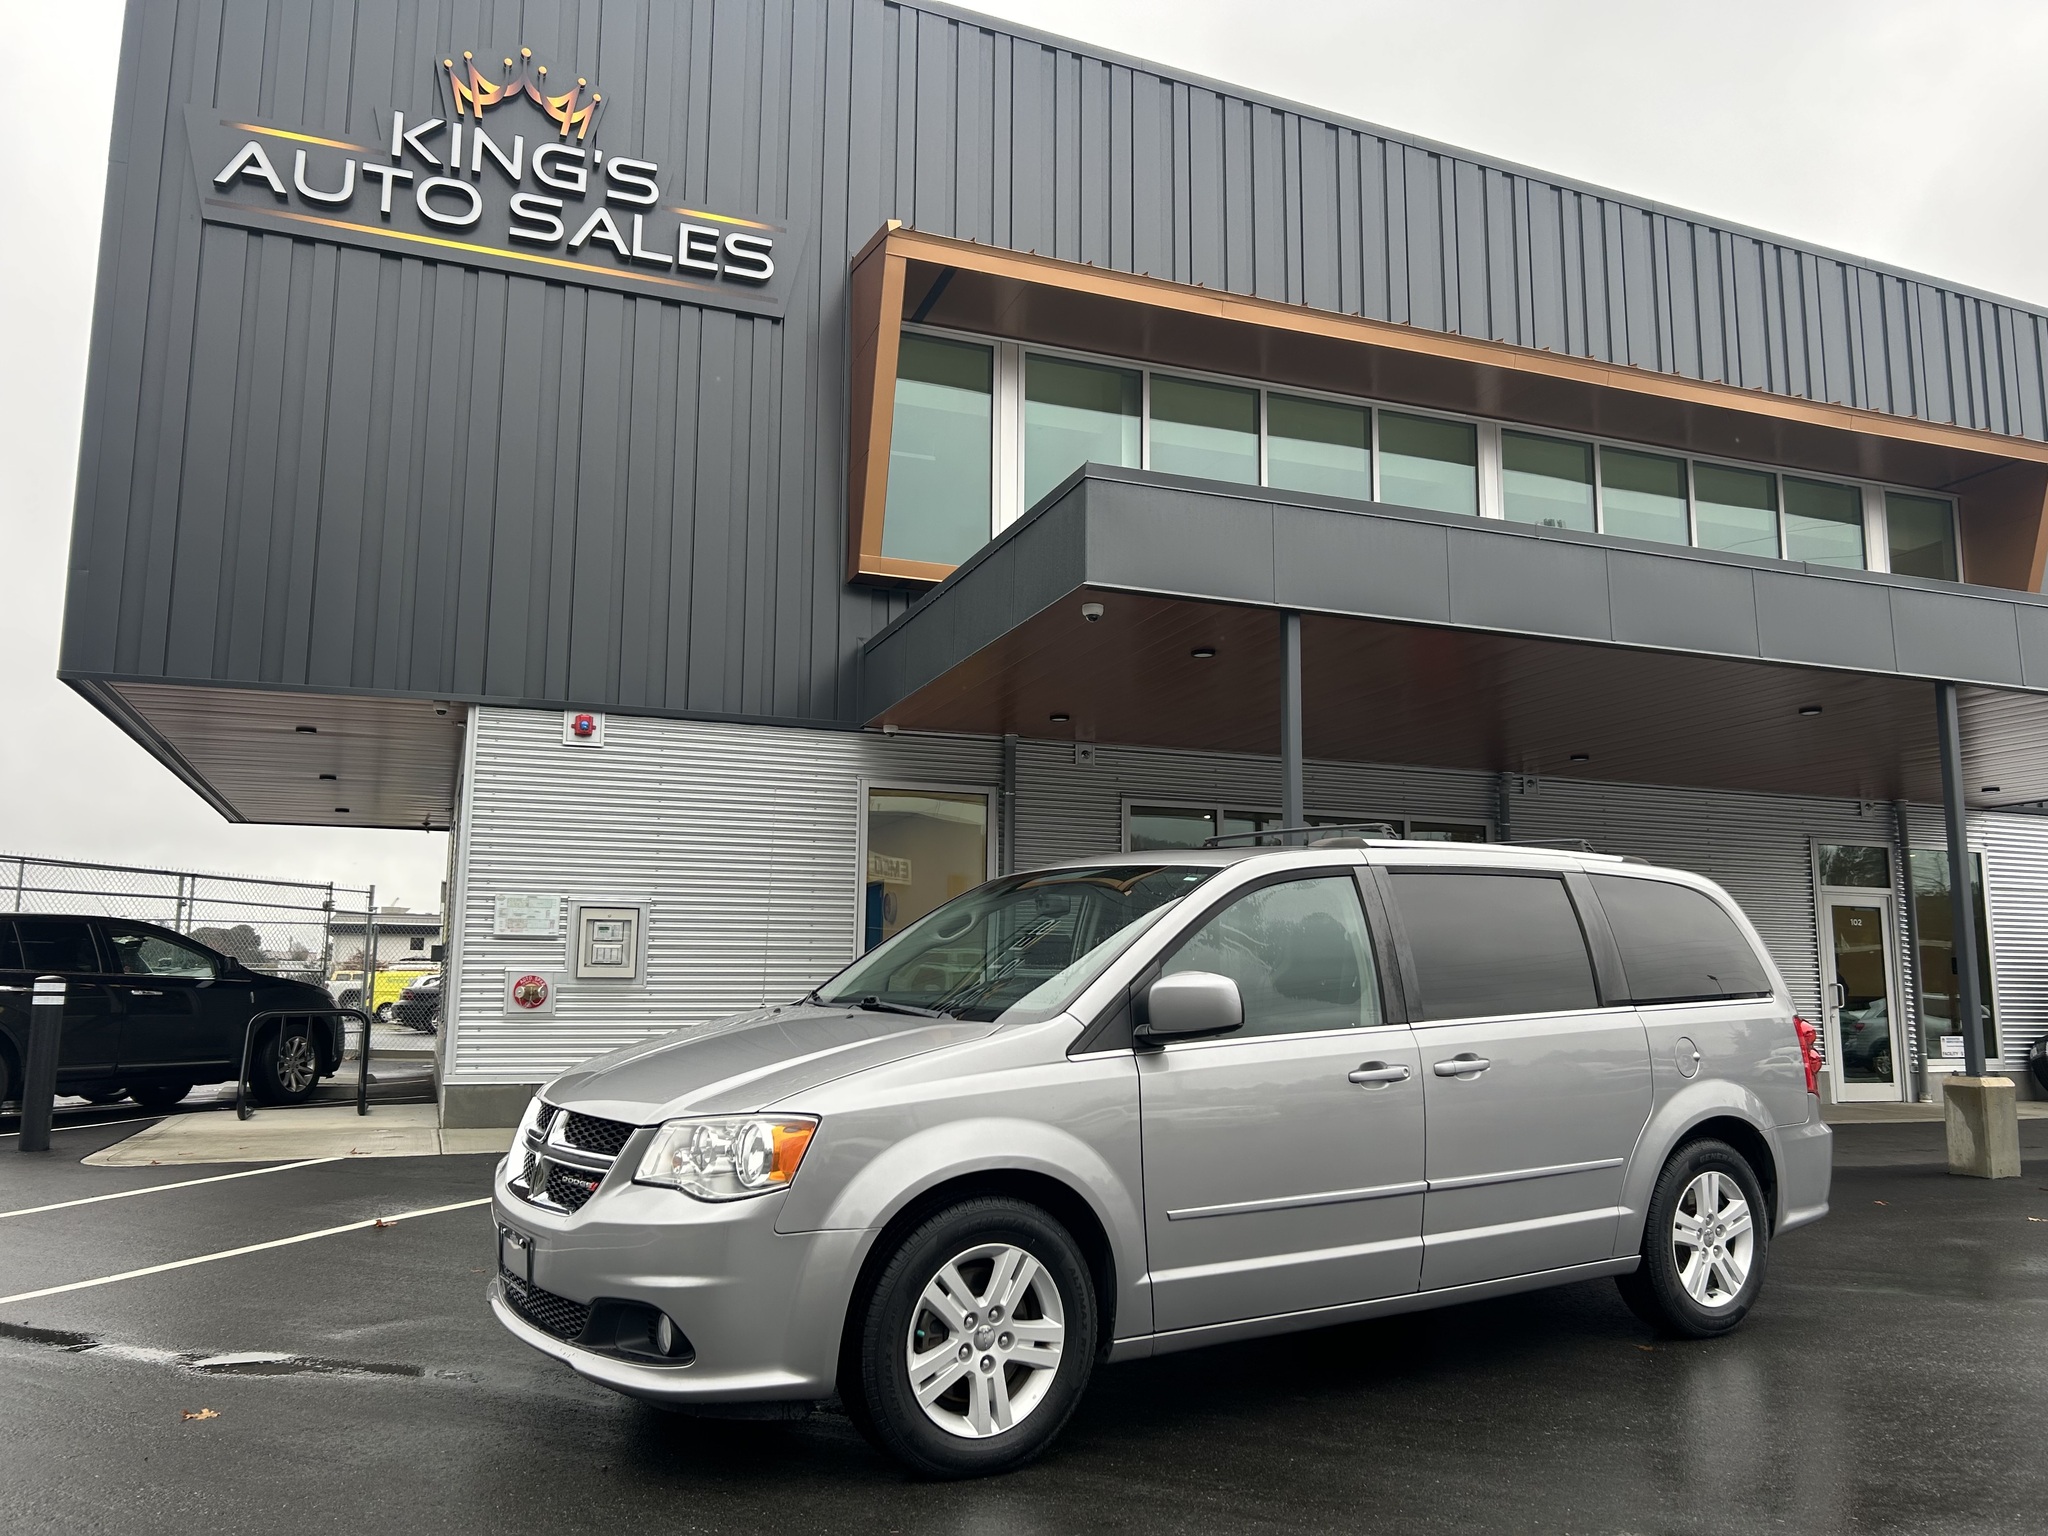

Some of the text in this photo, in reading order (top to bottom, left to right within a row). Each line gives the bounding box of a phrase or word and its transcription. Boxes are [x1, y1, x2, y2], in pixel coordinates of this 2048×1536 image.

[391, 110, 659, 207] KING'S
[213, 140, 775, 281] AUTO SALES
[1850, 918, 1863, 927] 102
[519, 976, 533, 984] AUTO
[562, 1175, 591, 1189] DODGE
[1068, 1267, 1088, 1331] ALTIMAX
